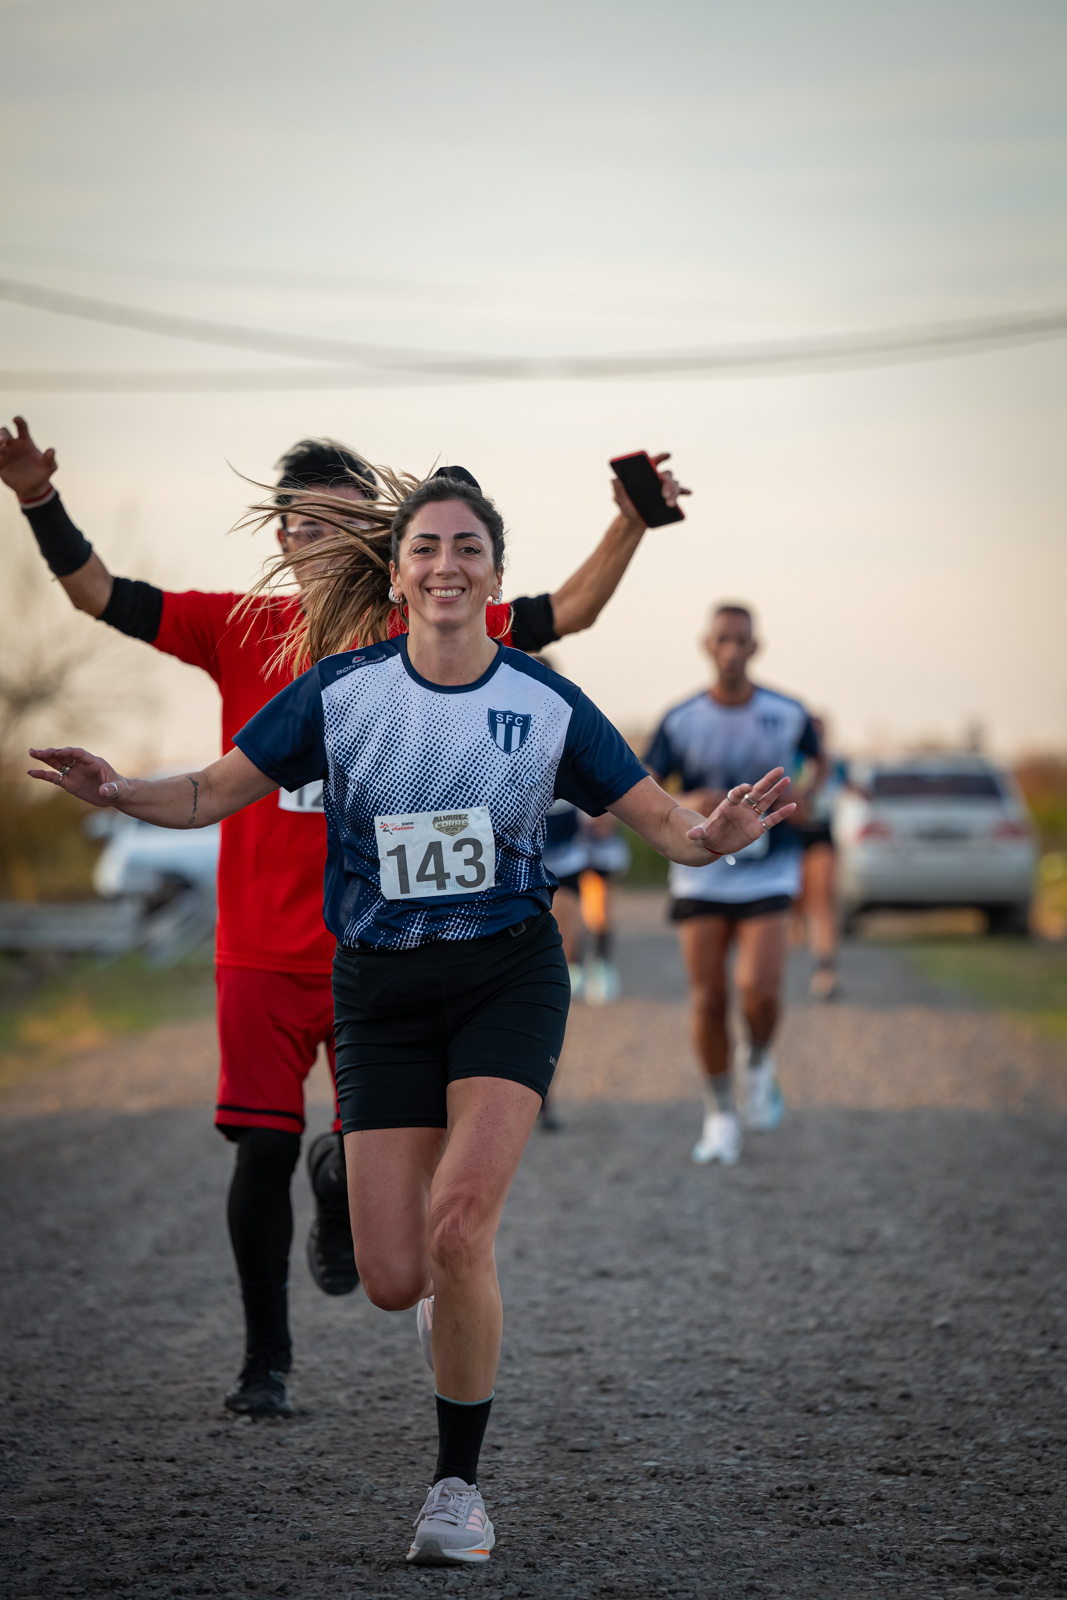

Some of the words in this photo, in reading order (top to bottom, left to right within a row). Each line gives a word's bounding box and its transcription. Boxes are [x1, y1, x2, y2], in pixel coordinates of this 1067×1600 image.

[495, 713, 523, 726] SFC
[433, 814, 468, 822] ALVAREZ
[435, 820, 468, 829] CORRE
[386, 837, 486, 895] 143
